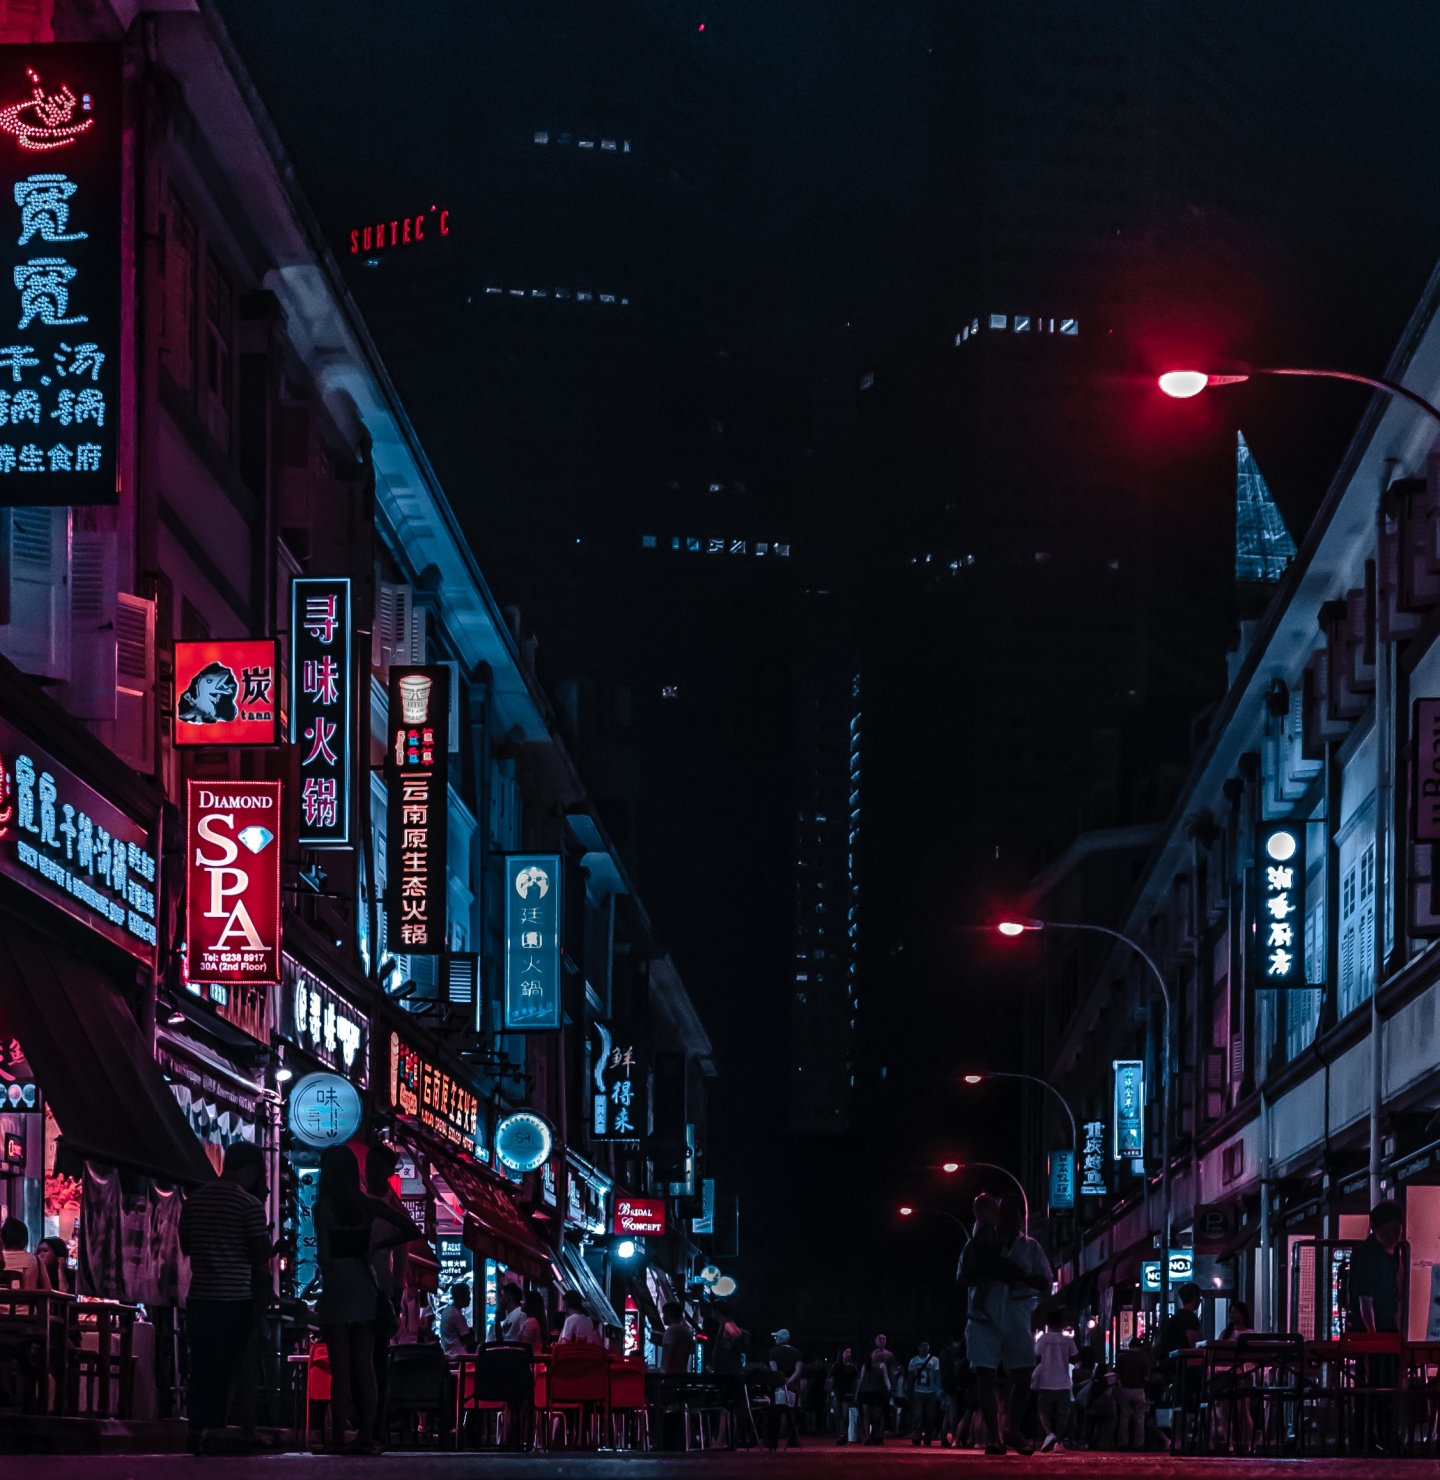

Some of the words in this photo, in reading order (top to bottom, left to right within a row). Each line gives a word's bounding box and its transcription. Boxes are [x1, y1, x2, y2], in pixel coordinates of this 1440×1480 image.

[240, 666, 273, 705] 炭
[301, 593, 339, 828] 寻味火锅
[195, 813, 273, 951] SPA
[400, 780, 429, 945] 云南原生态火锅
[199, 962, 217, 972] 30A
[239, 962, 267, 973] Floor)
[203, 953, 219, 962] Tel:
[220, 953, 242, 962] 6238
[243, 953, 265, 962] 8917
[609, 1045, 636, 1134] 鲜得来
